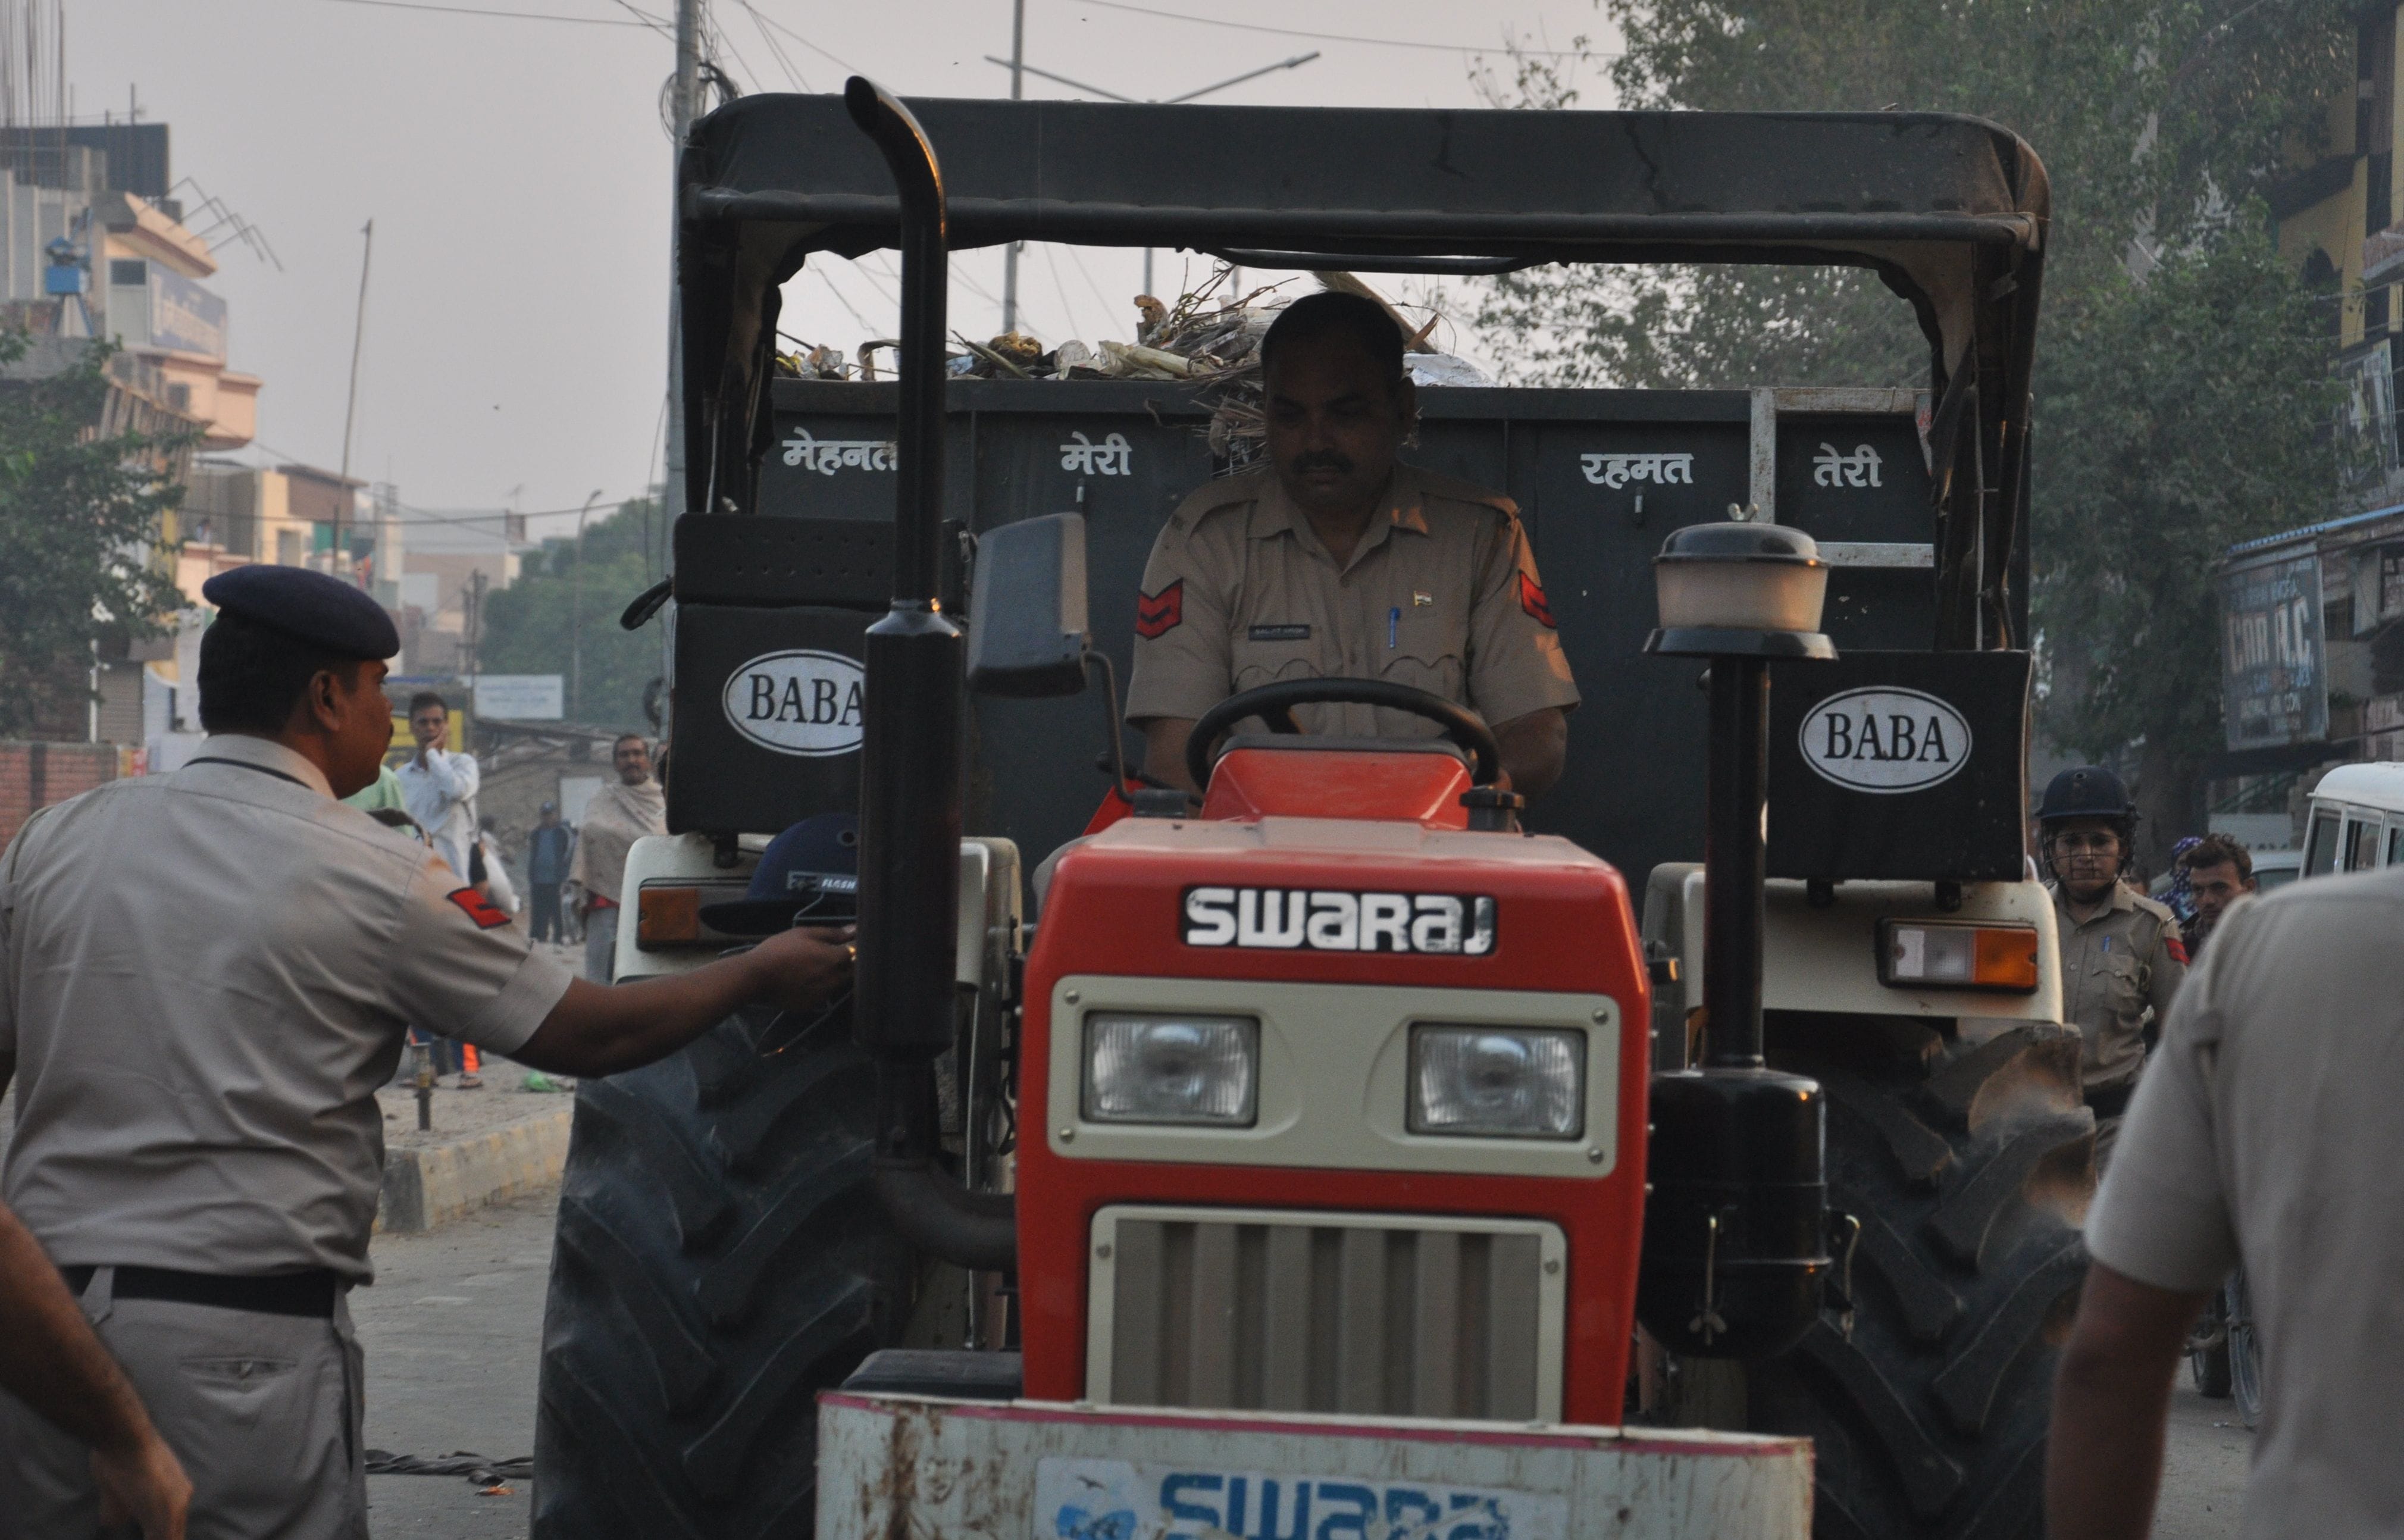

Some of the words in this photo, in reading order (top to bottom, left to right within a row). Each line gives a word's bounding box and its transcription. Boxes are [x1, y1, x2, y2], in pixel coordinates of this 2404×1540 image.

[782, 427, 898, 476] मेहनत
[1060, 431, 1132, 476] मेरी
[1580, 453, 1695, 490] रहमत
[1813, 442, 1883, 488] तेरी
[747, 674, 864, 727] BABA
[1823, 712, 1949, 763] BABA
